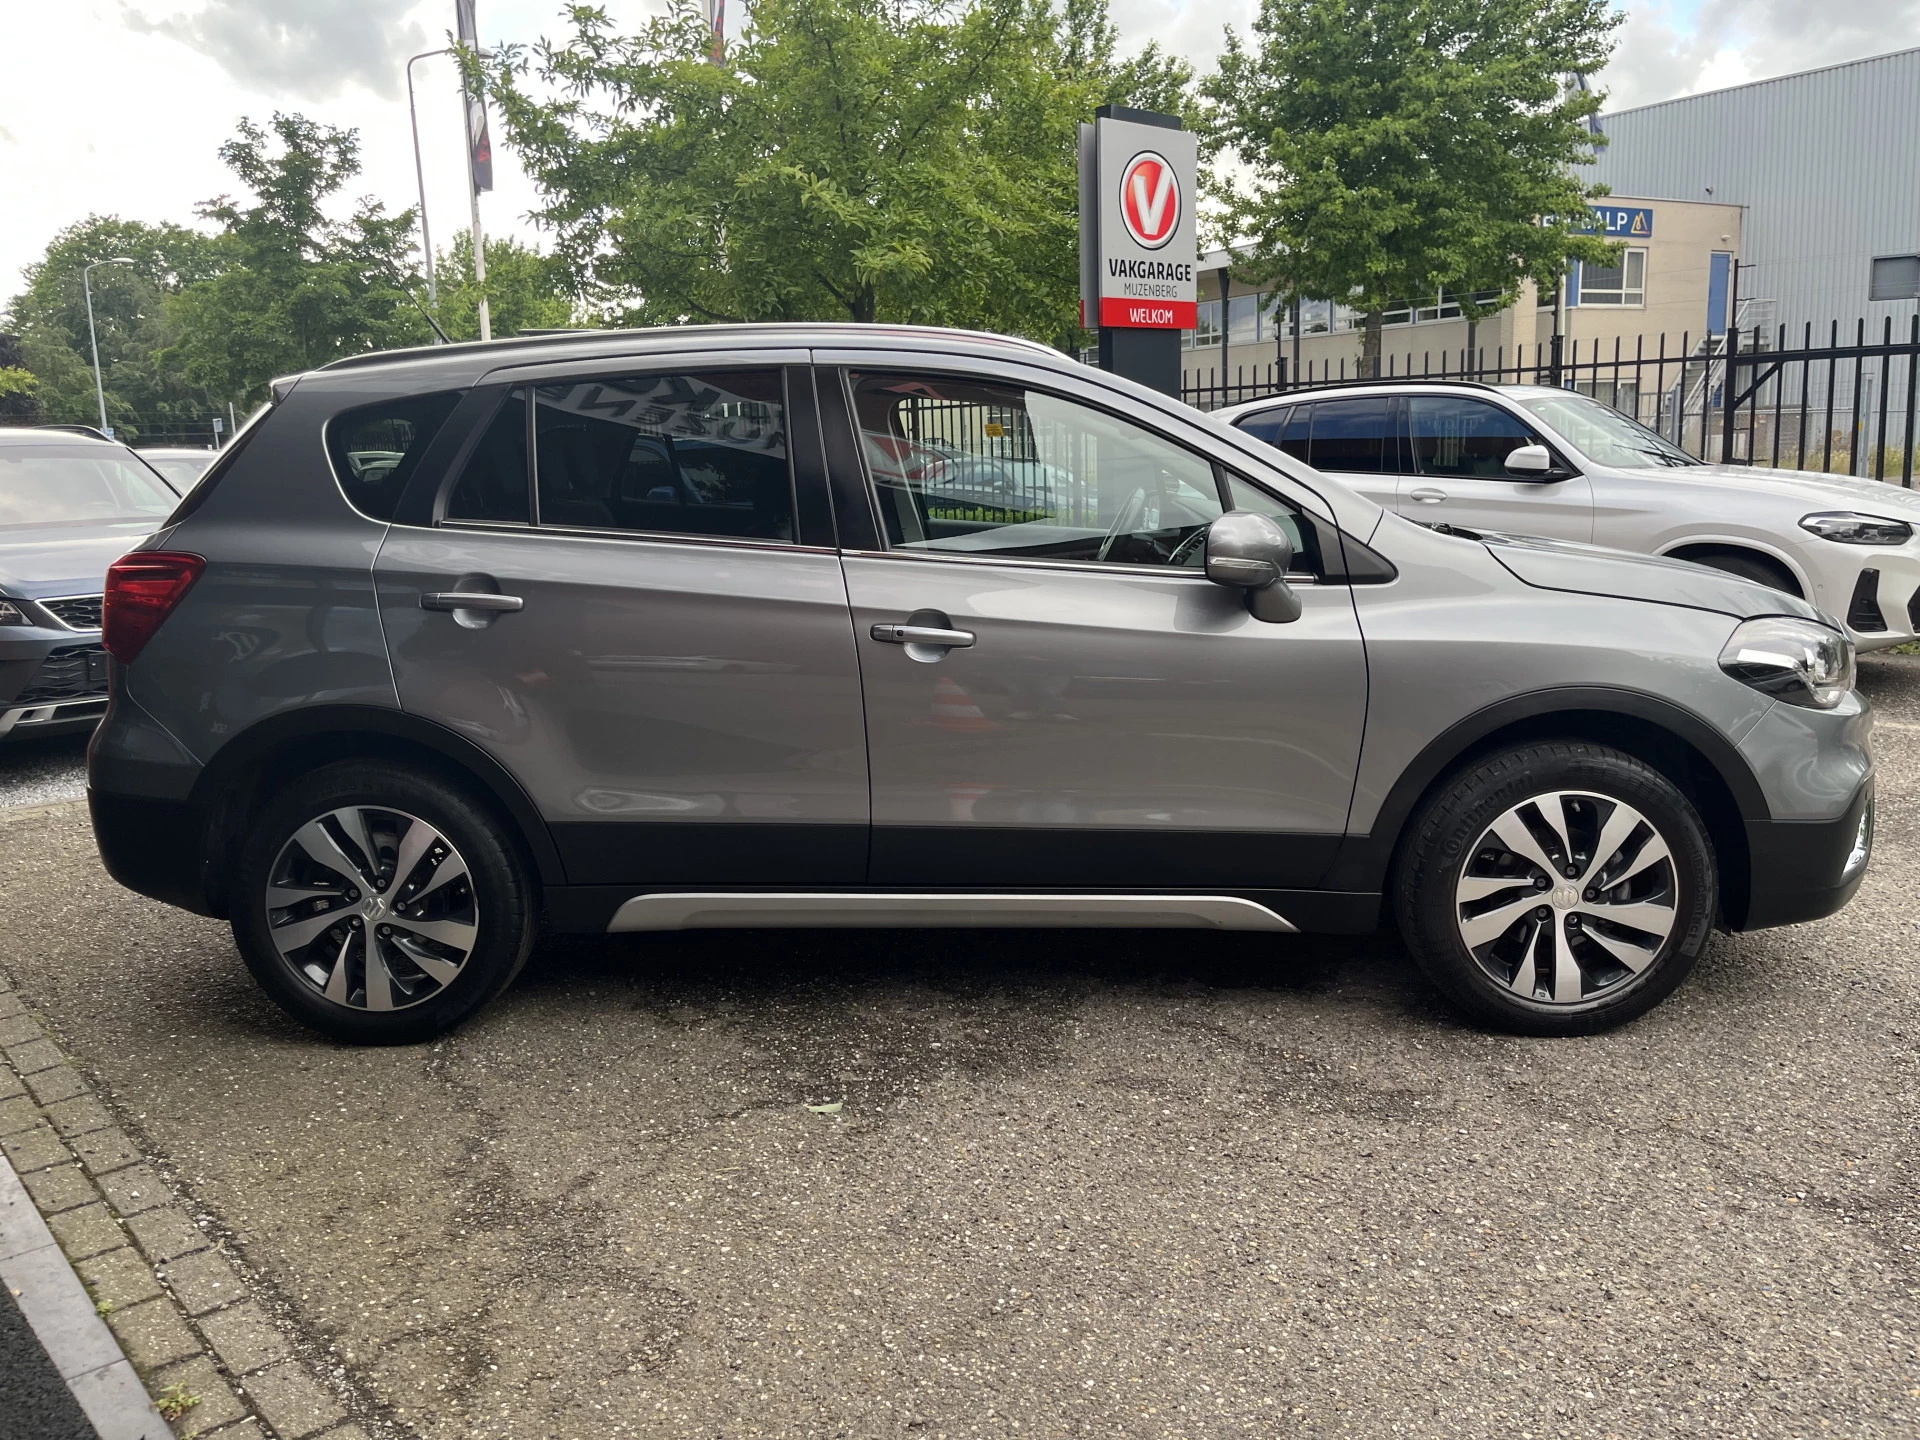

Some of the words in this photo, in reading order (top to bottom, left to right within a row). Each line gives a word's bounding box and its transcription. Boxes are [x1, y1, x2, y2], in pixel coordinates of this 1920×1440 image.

[1133, 164, 1173, 235] V
[1109, 258, 1191, 282] VAKGARAGE
[1124, 283, 1177, 298] MUZENBERG
[1129, 308, 1173, 324] WELKOM
